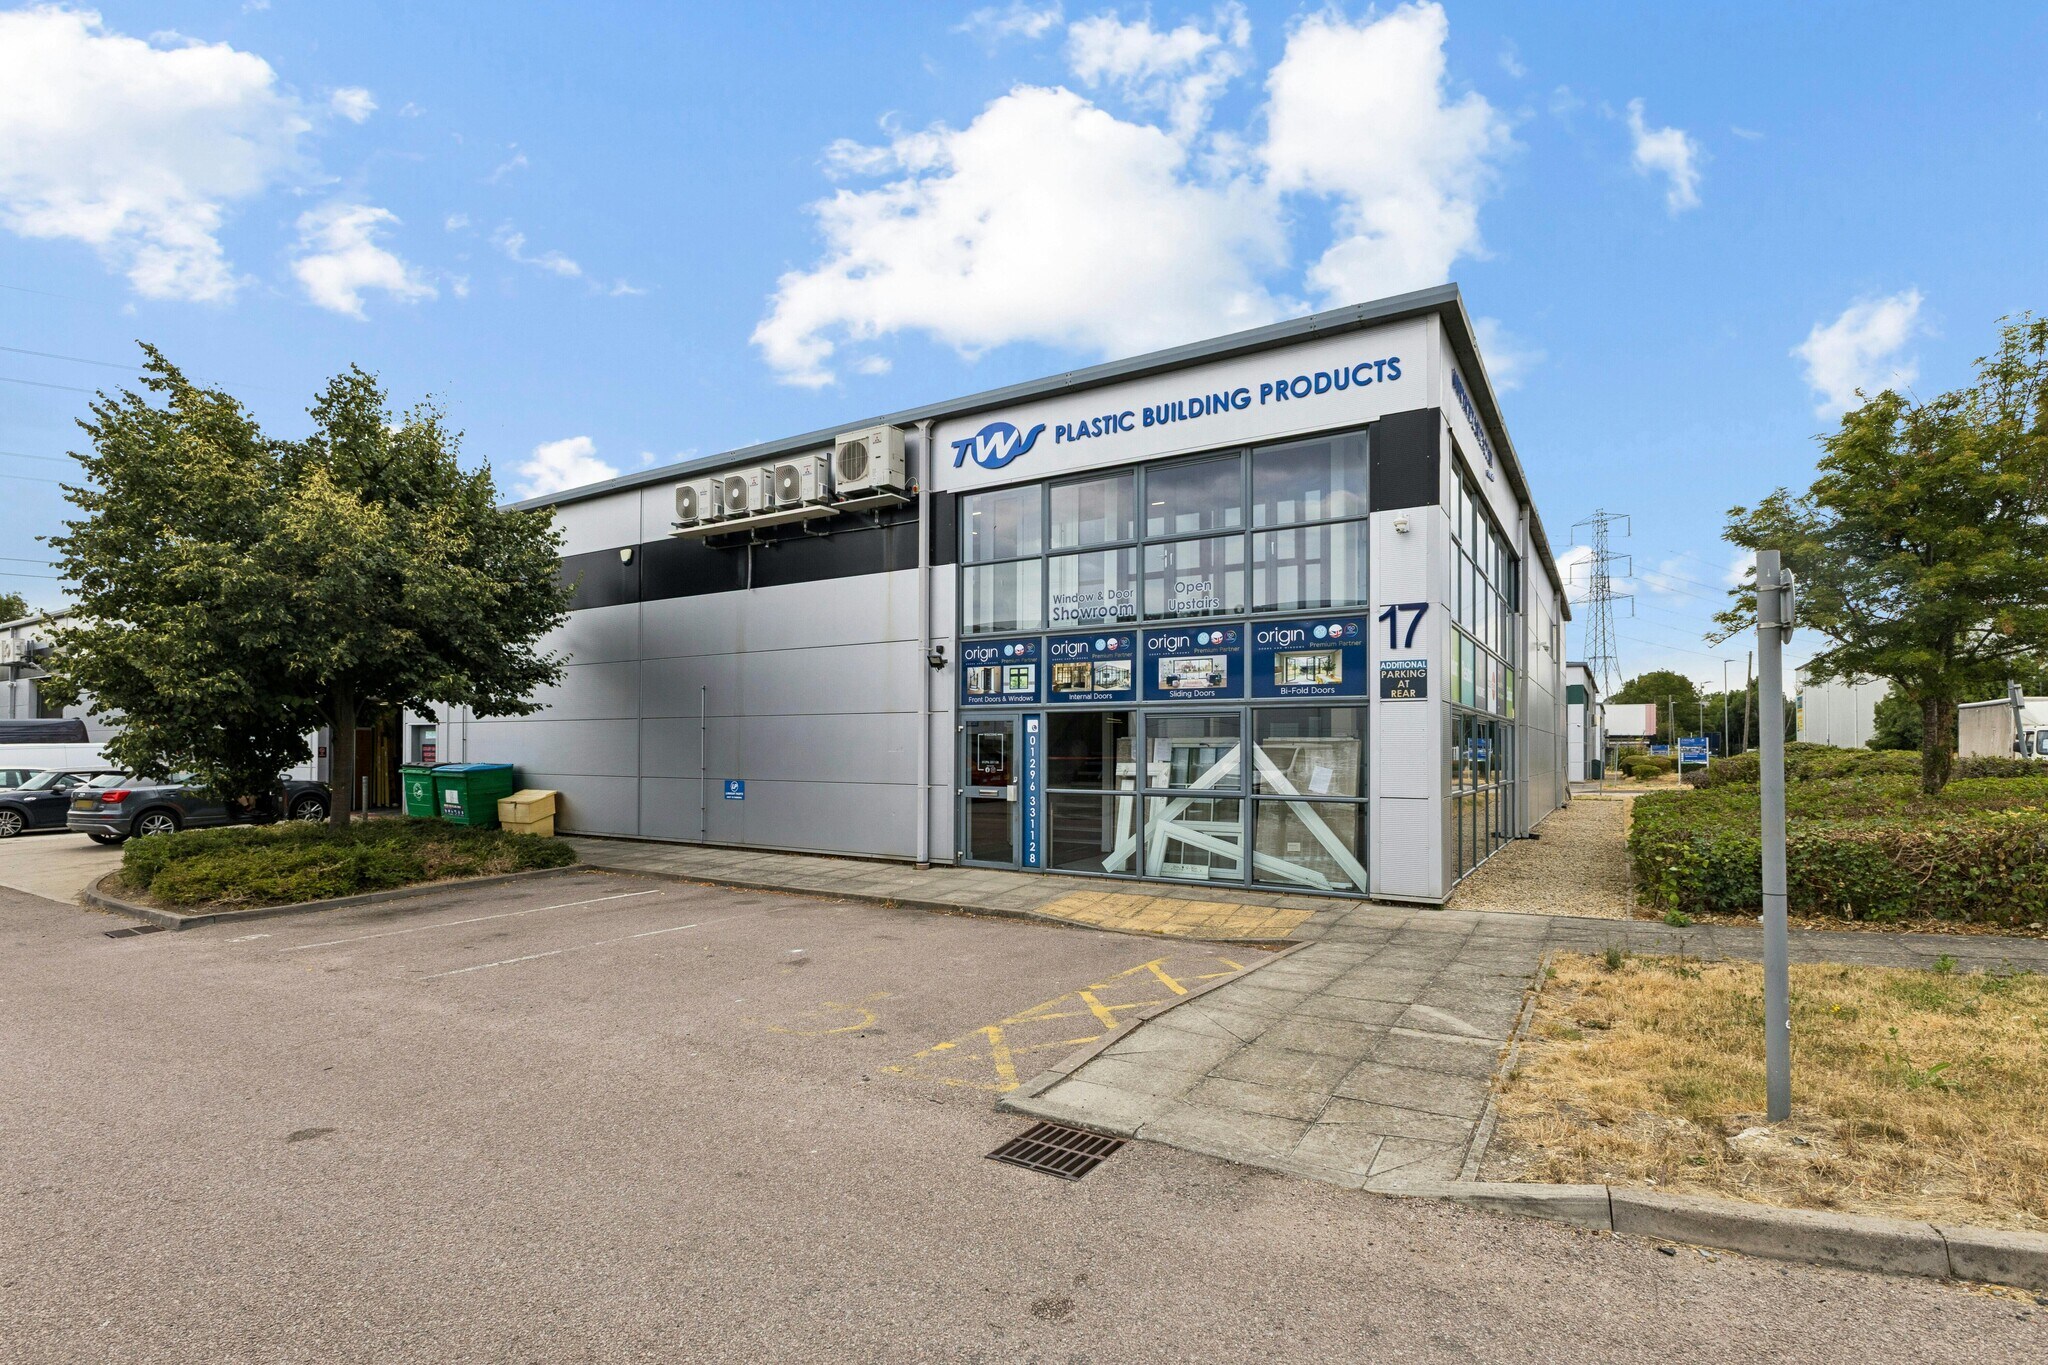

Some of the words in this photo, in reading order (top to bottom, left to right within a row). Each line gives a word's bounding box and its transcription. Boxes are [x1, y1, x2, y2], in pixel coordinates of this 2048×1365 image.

[951, 422, 1046, 469] TWS
[1055, 411, 1135, 444] PLASTIC
[1142, 387, 1251, 427] BUILDING
[1260, 356, 1401, 404] PRODUCTS
[1174, 581, 1212, 595] Open
[1053, 591, 1094, 604] Window
[1097, 591, 1104, 600] &
[1108, 589, 1134, 600] Door
[1053, 603, 1134, 621] Showroom
[1168, 597, 1219, 613] Upstairs
[1379, 602, 1429, 649] 17
[1148, 634, 1190, 652] origin
[1257, 627, 1305, 646] origin
[964, 646, 999, 662] origin
[1051, 640, 1089, 657] origin
[1380, 661, 1426, 669] ADDITIONAL
[1381, 669, 1426, 678] PARKING
[1397, 679, 1410, 688] AT
[1169, 690, 1192, 698] Sliding
[1194, 689, 1215, 697] Doors
[1391, 689, 1416, 698] REAR
